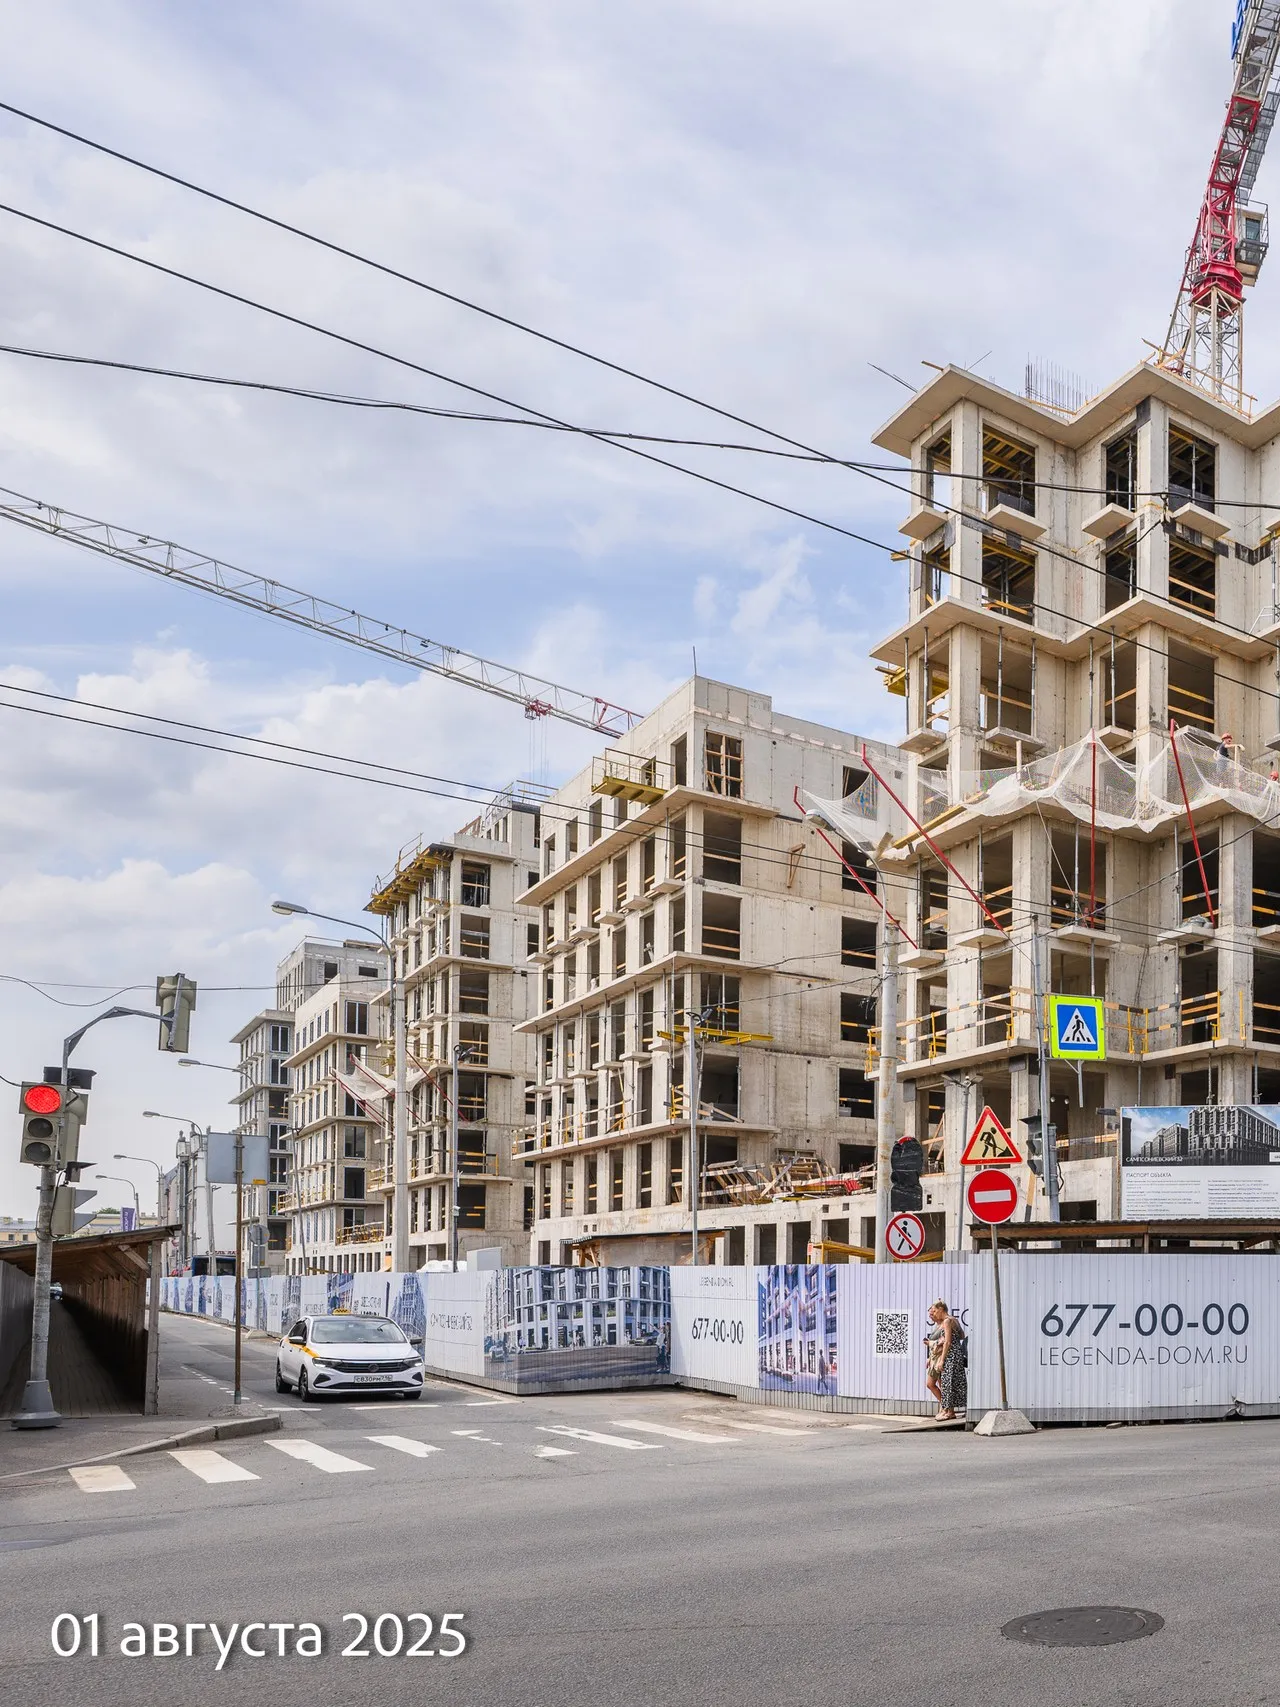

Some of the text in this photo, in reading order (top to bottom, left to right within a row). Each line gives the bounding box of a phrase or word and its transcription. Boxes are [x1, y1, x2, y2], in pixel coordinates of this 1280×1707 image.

[692, 1318, 744, 1344] 677-00-00
[1041, 1303, 1249, 1337] 677-00-00
[1040, 1345, 1248, 1366] LEGENDA-DOM.RU
